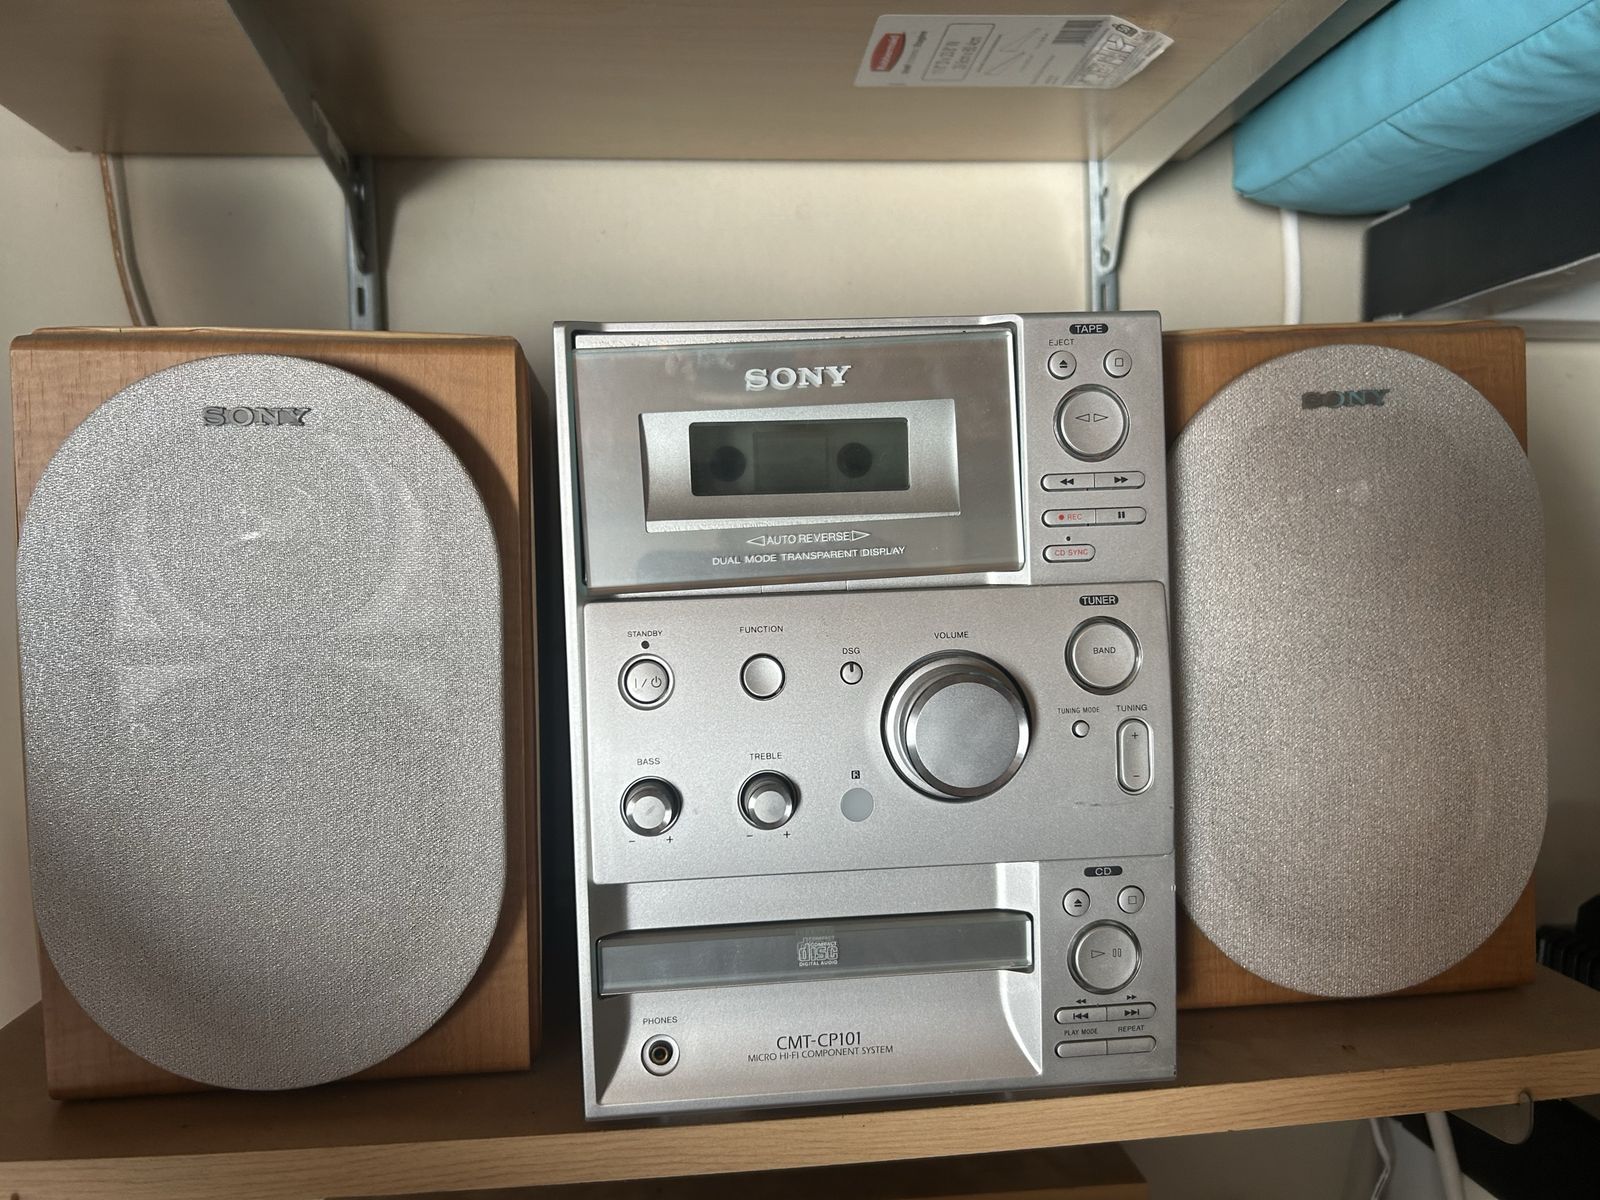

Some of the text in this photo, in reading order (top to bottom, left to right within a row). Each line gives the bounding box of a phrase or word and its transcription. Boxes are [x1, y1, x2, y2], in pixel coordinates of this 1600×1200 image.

[1074, 324, 1103, 333] TAPE
[745, 365, 851, 391] SONY
[203, 406, 312, 426] SONY
[1067, 512, 1083, 520] REC
[767, 531, 851, 545] AUTO REVERSE
[712, 546, 906, 566] DUAL MODE TRANSPARENT DISPLAY
[1054, 548, 1089, 557] CD SYNC
[1082, 595, 1116, 605] TUNER
[627, 630, 663, 638] STANDBY
[739, 625, 784, 634] FUNCTION
[934, 631, 969, 640] VOLUME
[842, 647, 861, 655] DSG
[1093, 646, 1116, 655] BAND
[1116, 704, 1148, 712] TUNING
[749, 752, 782, 761] TREBLE
[637, 757, 661, 766] BASS
[1095, 867, 1112, 876] CD
[642, 1015, 678, 1025] PHONES
[776, 1031, 862, 1050] CMT-CP101
[748, 1045, 894, 1062] MICRO HI-FI COMPONENT SYSTEM
